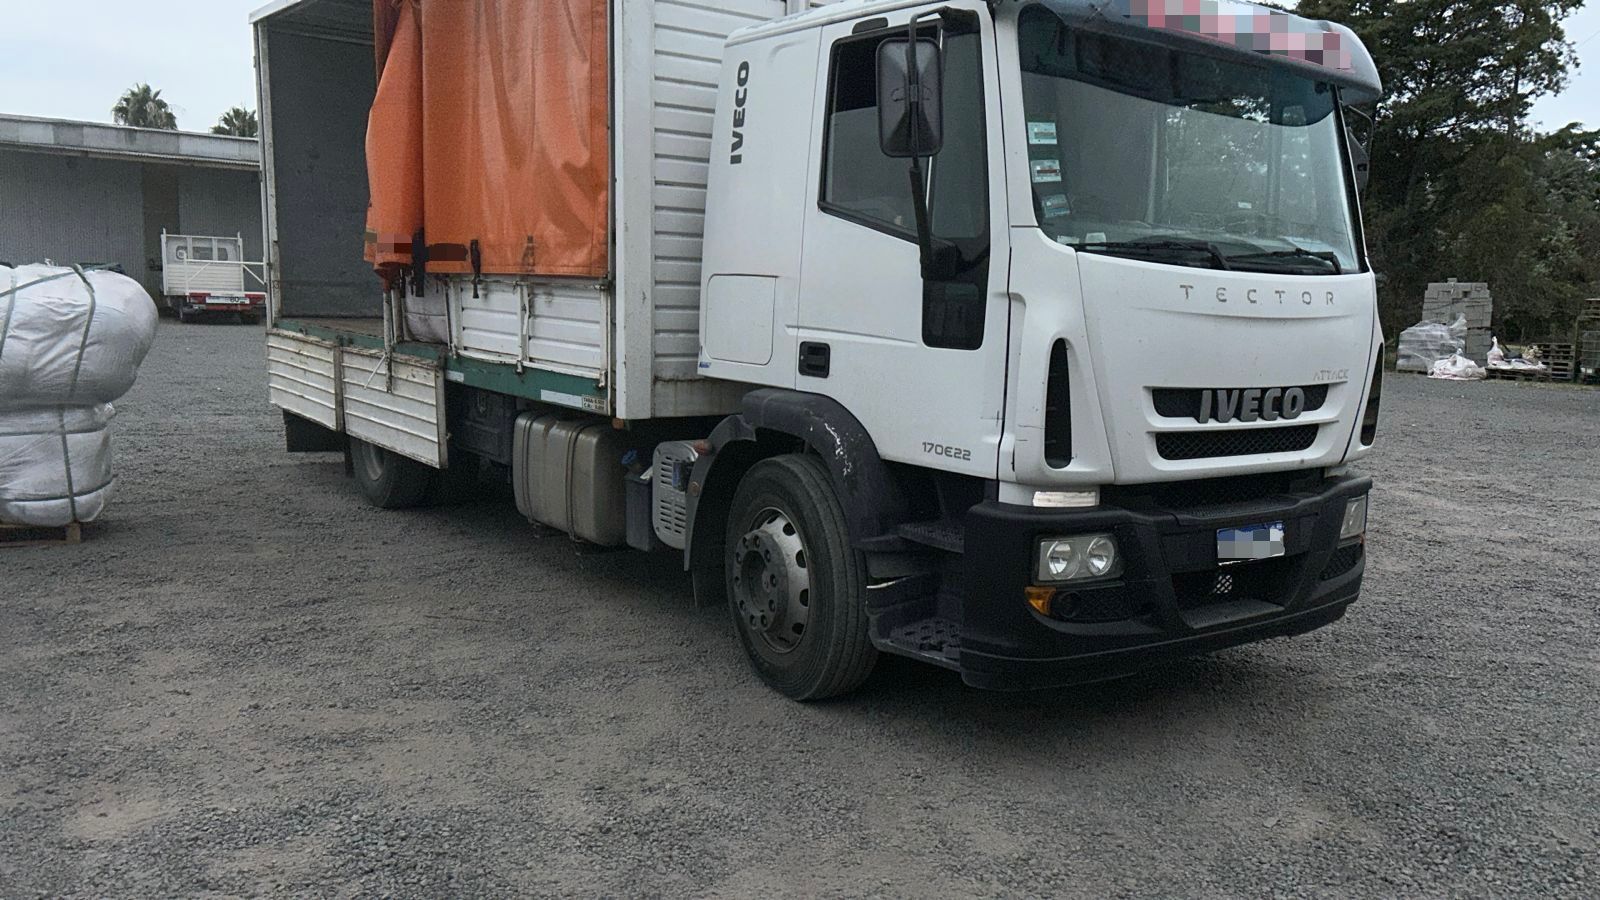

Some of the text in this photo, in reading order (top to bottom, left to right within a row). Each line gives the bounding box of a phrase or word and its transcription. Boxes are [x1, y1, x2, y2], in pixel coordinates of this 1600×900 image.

[730, 61, 749, 165] IVECO
[1180, 284, 1335, 305] TECTOR
[1199, 387, 1305, 424] IVECO
[922, 441, 972, 462] 170E22
